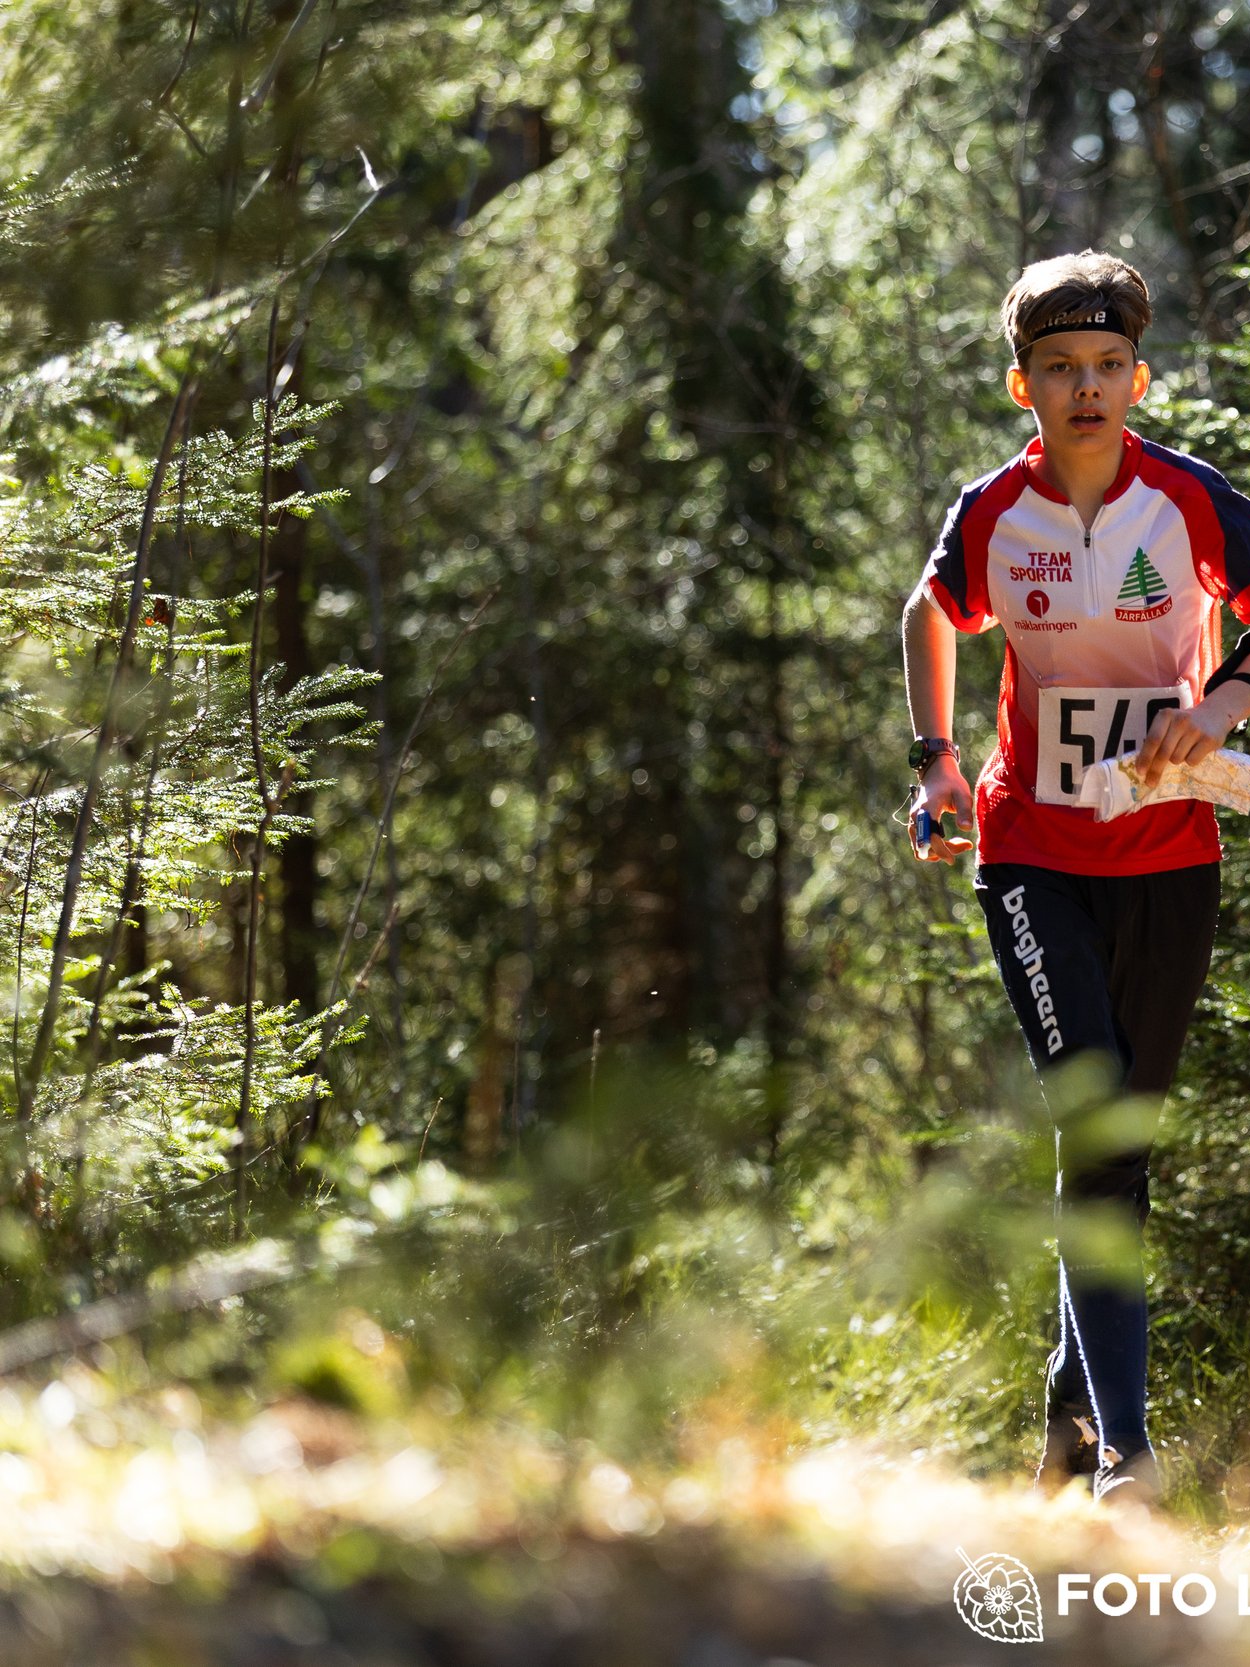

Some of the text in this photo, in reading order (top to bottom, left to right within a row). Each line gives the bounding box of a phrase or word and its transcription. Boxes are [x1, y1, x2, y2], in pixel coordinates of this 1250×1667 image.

[1028, 552, 1072, 567] TEAM
[1009, 566, 1073, 583] SPORTIA
[1014, 619, 1078, 634] mäklarringen
[1001, 884, 1064, 1056] bagheera
